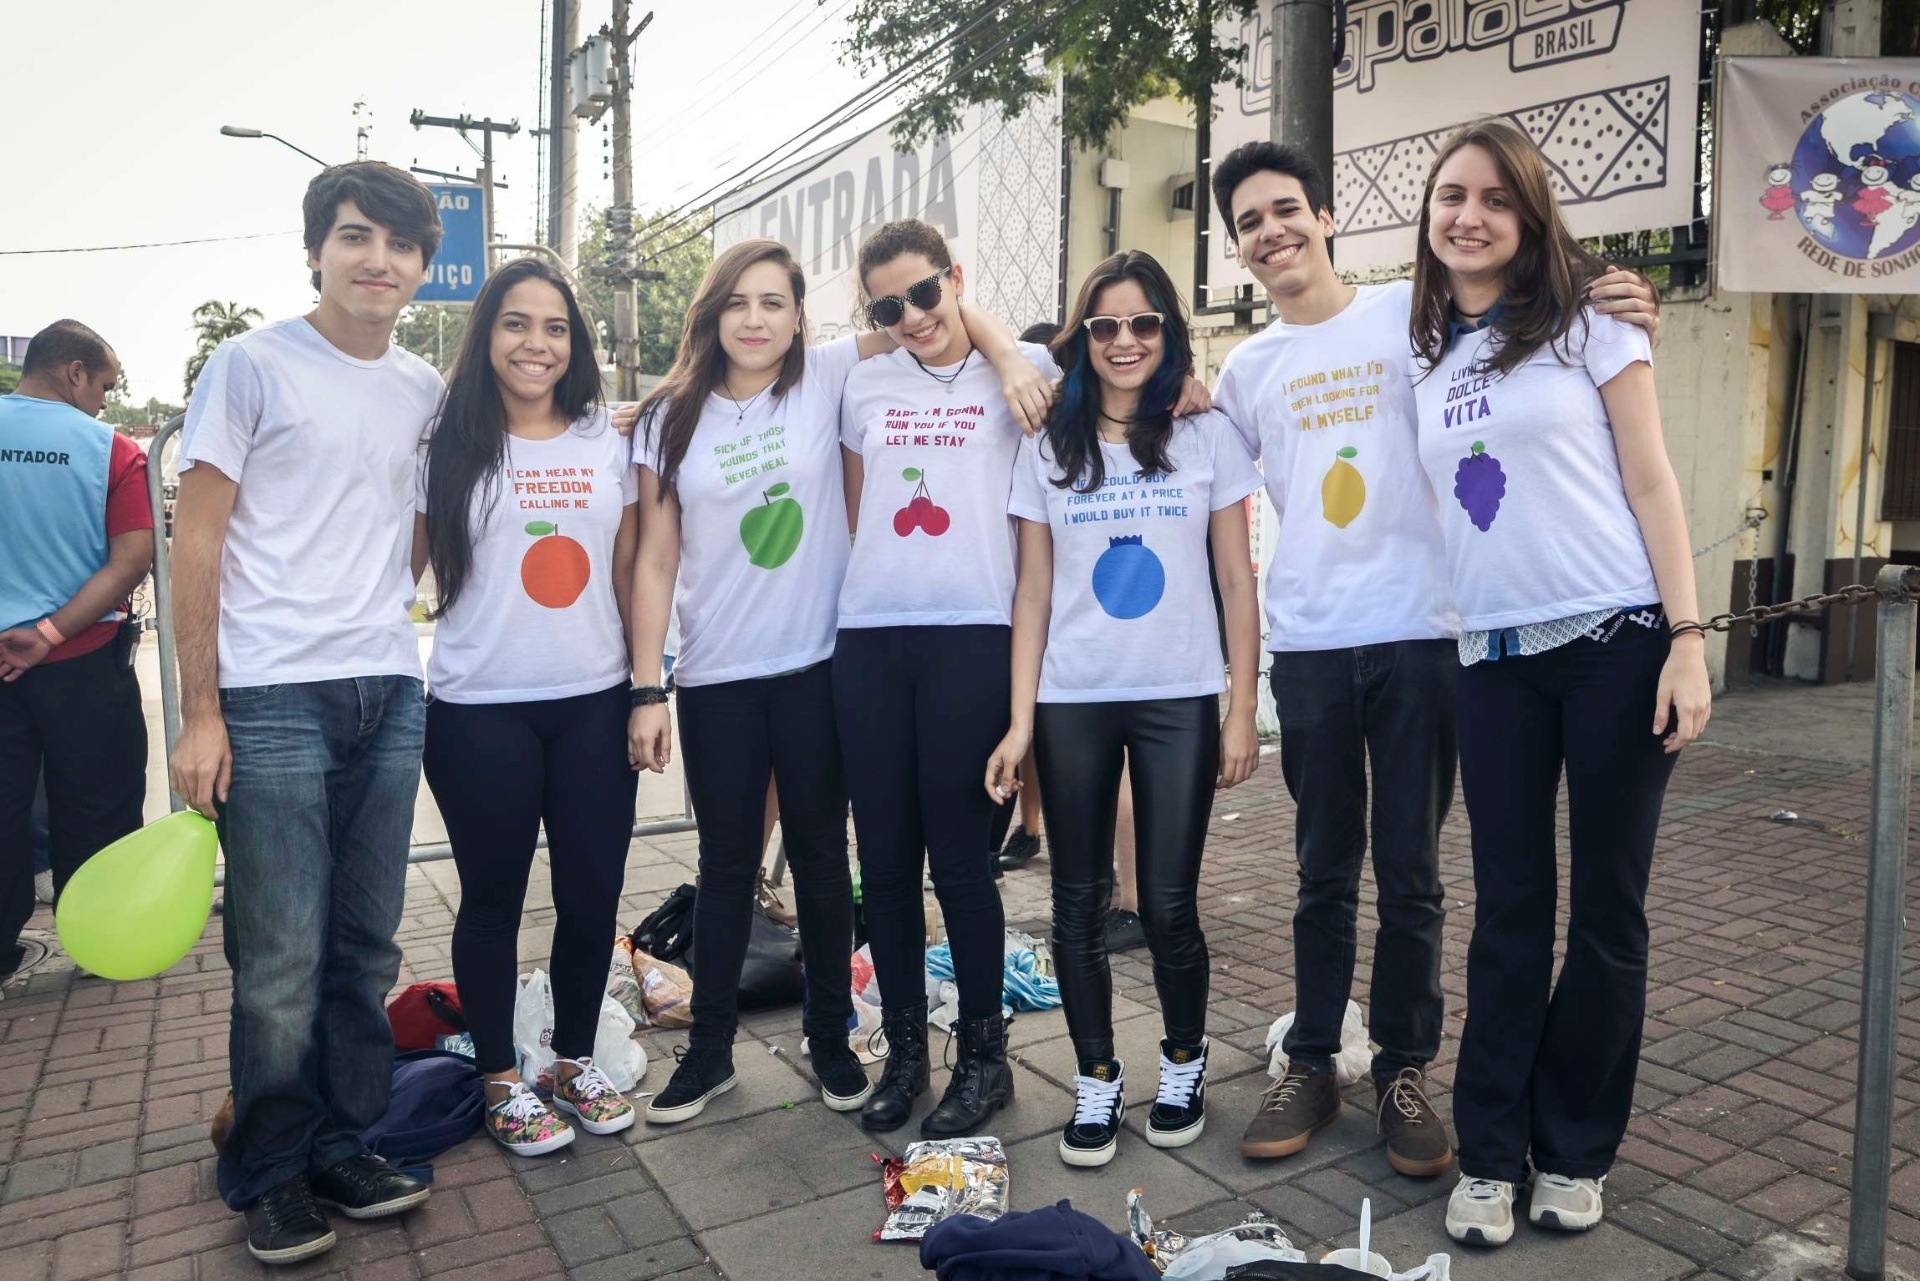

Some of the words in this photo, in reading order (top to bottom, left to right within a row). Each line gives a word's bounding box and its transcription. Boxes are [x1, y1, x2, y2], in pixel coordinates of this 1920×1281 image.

[1534, 19, 1596, 59] BRASIL
[1800, 74, 1901, 124] Associação
[434, 191, 470, 211] ÃO
[1797, 236, 1839, 273] REDE
[1843, 260, 1866, 278] DE
[1282, 382, 1287, 396] I
[1289, 372, 1326, 392] FOUND
[1331, 365, 1361, 381] WHAT
[1366, 360, 1383, 375] I'D
[1291, 396, 1312, 412] BEEN
[1316, 388, 1355, 404] LOOKING
[1360, 384, 1380, 396] FOR
[1446, 376, 1490, 403] DOLCE
[946, 405, 985, 417] GONNA
[1317, 405, 1374, 428] MYSELF
[1443, 395, 1491, 428] VITA
[885, 420, 909, 430] RUIN
[914, 422, 935, 430] YOU
[938, 421, 949, 429] IF
[954, 420, 976, 430] YOU
[713, 443, 737, 455] SICK
[886, 435, 909, 446] LET
[914, 435, 929, 446] ME
[934, 435, 965, 448] STAY
[0, 449, 70, 466] NTADOR
[720, 450, 758, 469] WOUNDS
[761, 438, 786, 454] THAT
[507, 468, 511, 479] I
[516, 470, 541, 478] CAN
[545, 468, 577, 477] HEAR
[581, 468, 594, 477] MY
[725, 466, 758, 485] NEVER
[761, 456, 789, 473] HEAL
[1145, 473, 1168, 484] BUY
[514, 481, 593, 494] FREEDOM
[1067, 492, 1116, 506] FOREVER
[1121, 490, 1135, 501] AT
[1140, 489, 1148, 499] A
[1152, 488, 1184, 499] PRICE
[520, 499, 569, 509] CALLING
[574, 500, 589, 509] ME
[1064, 512, 1068, 526] I
[1072, 509, 1109, 524] WOULD
[1113, 508, 1135, 520] BUY
[1141, 507, 1151, 518] IT
[1157, 505, 1188, 517] TWICE
